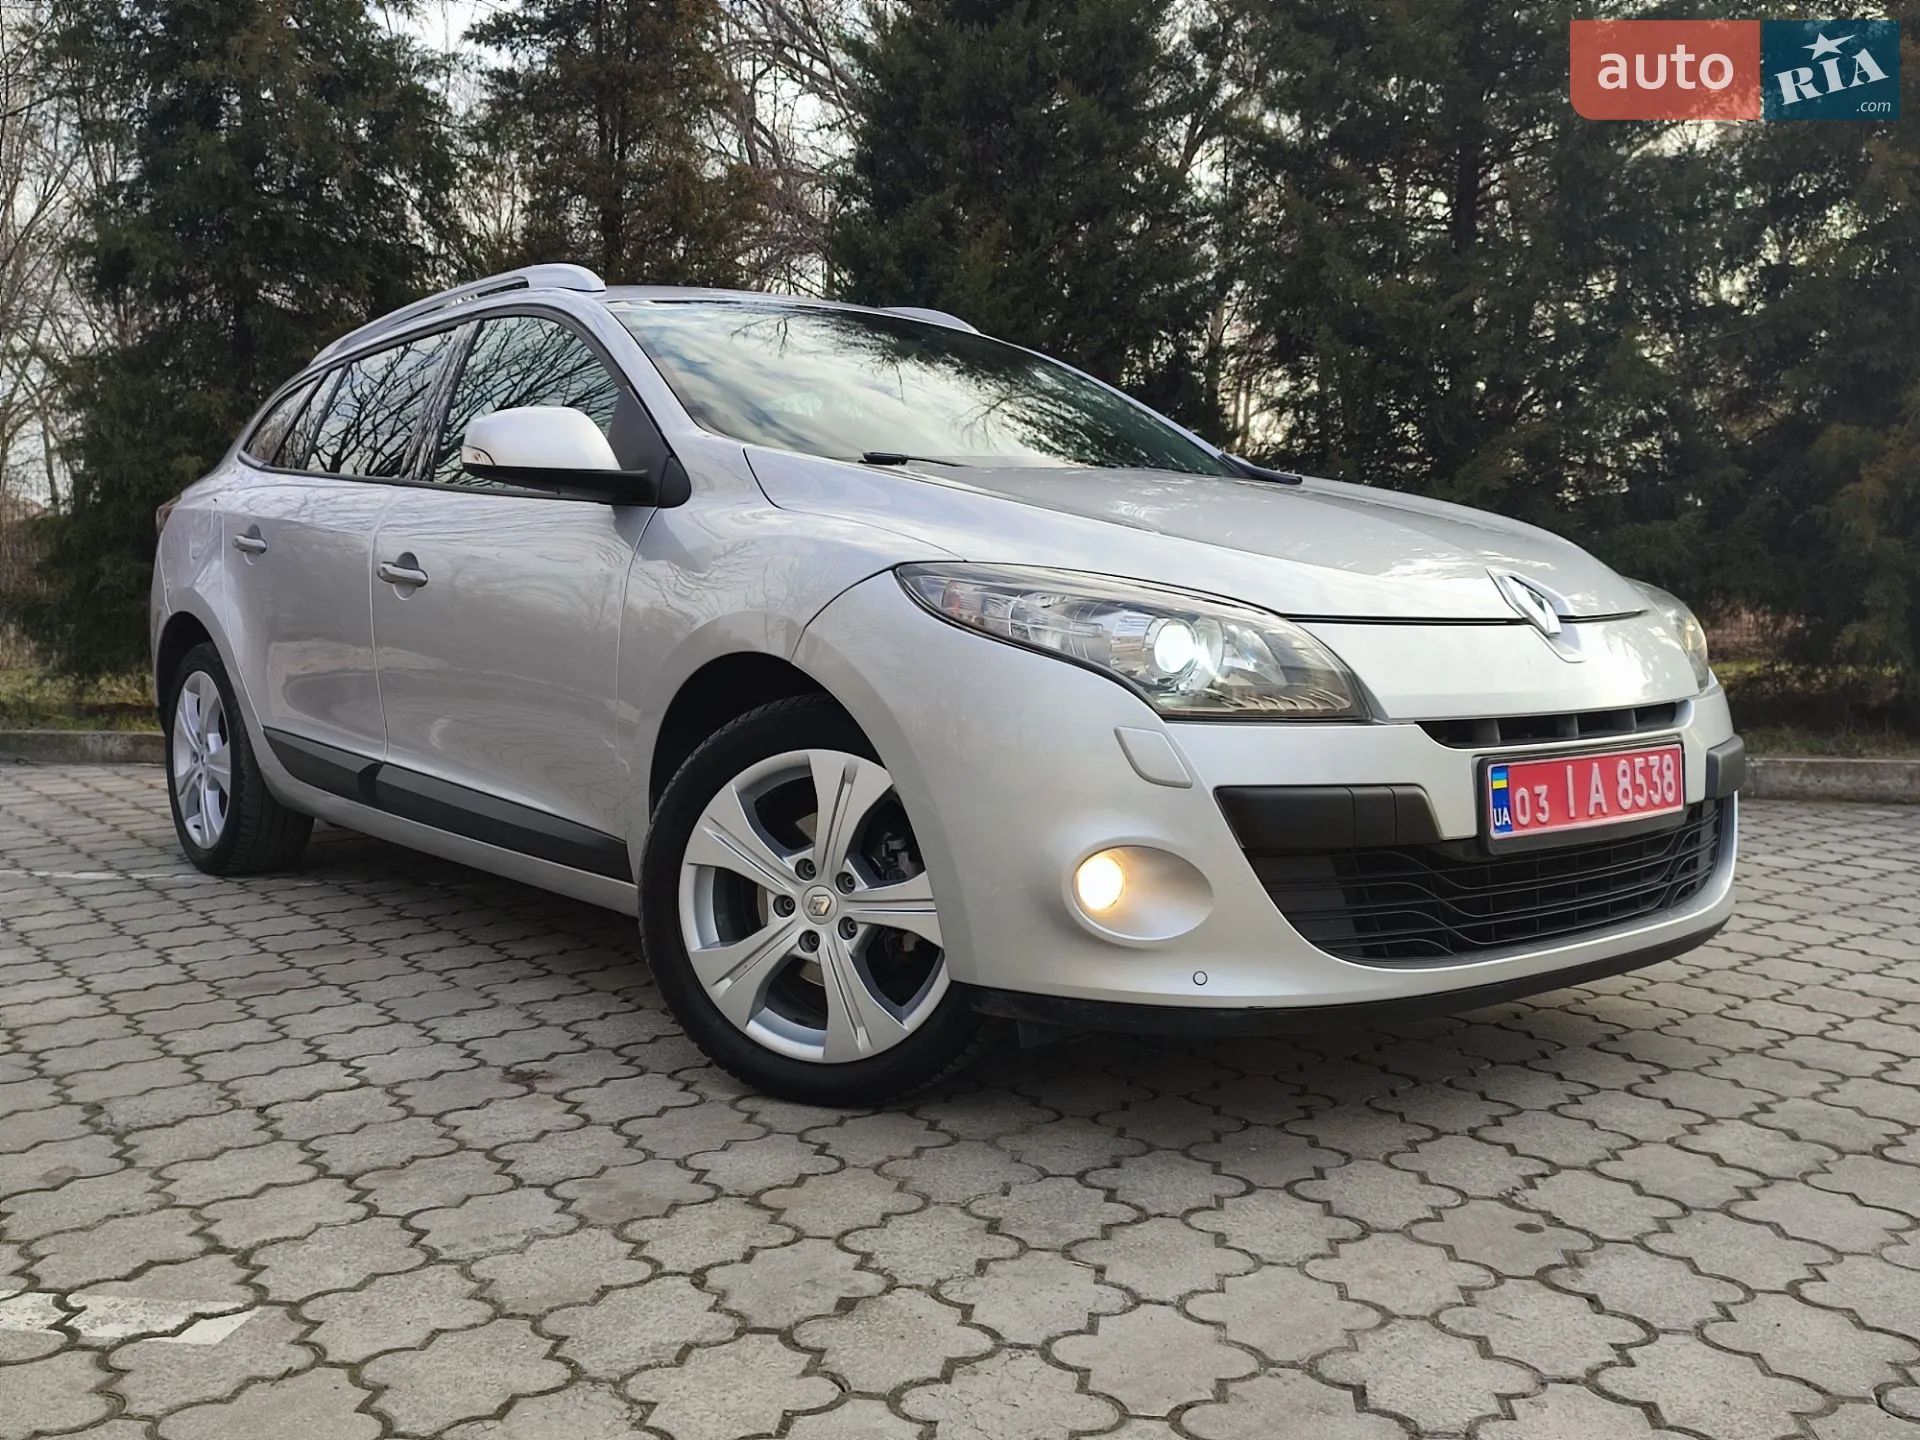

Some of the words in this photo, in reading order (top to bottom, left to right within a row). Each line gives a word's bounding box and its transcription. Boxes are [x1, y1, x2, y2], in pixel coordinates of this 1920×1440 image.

[1514, 785, 1549, 825] 03
[1616, 754, 1676, 810] 8538
[1493, 808, 1511, 826] UA
